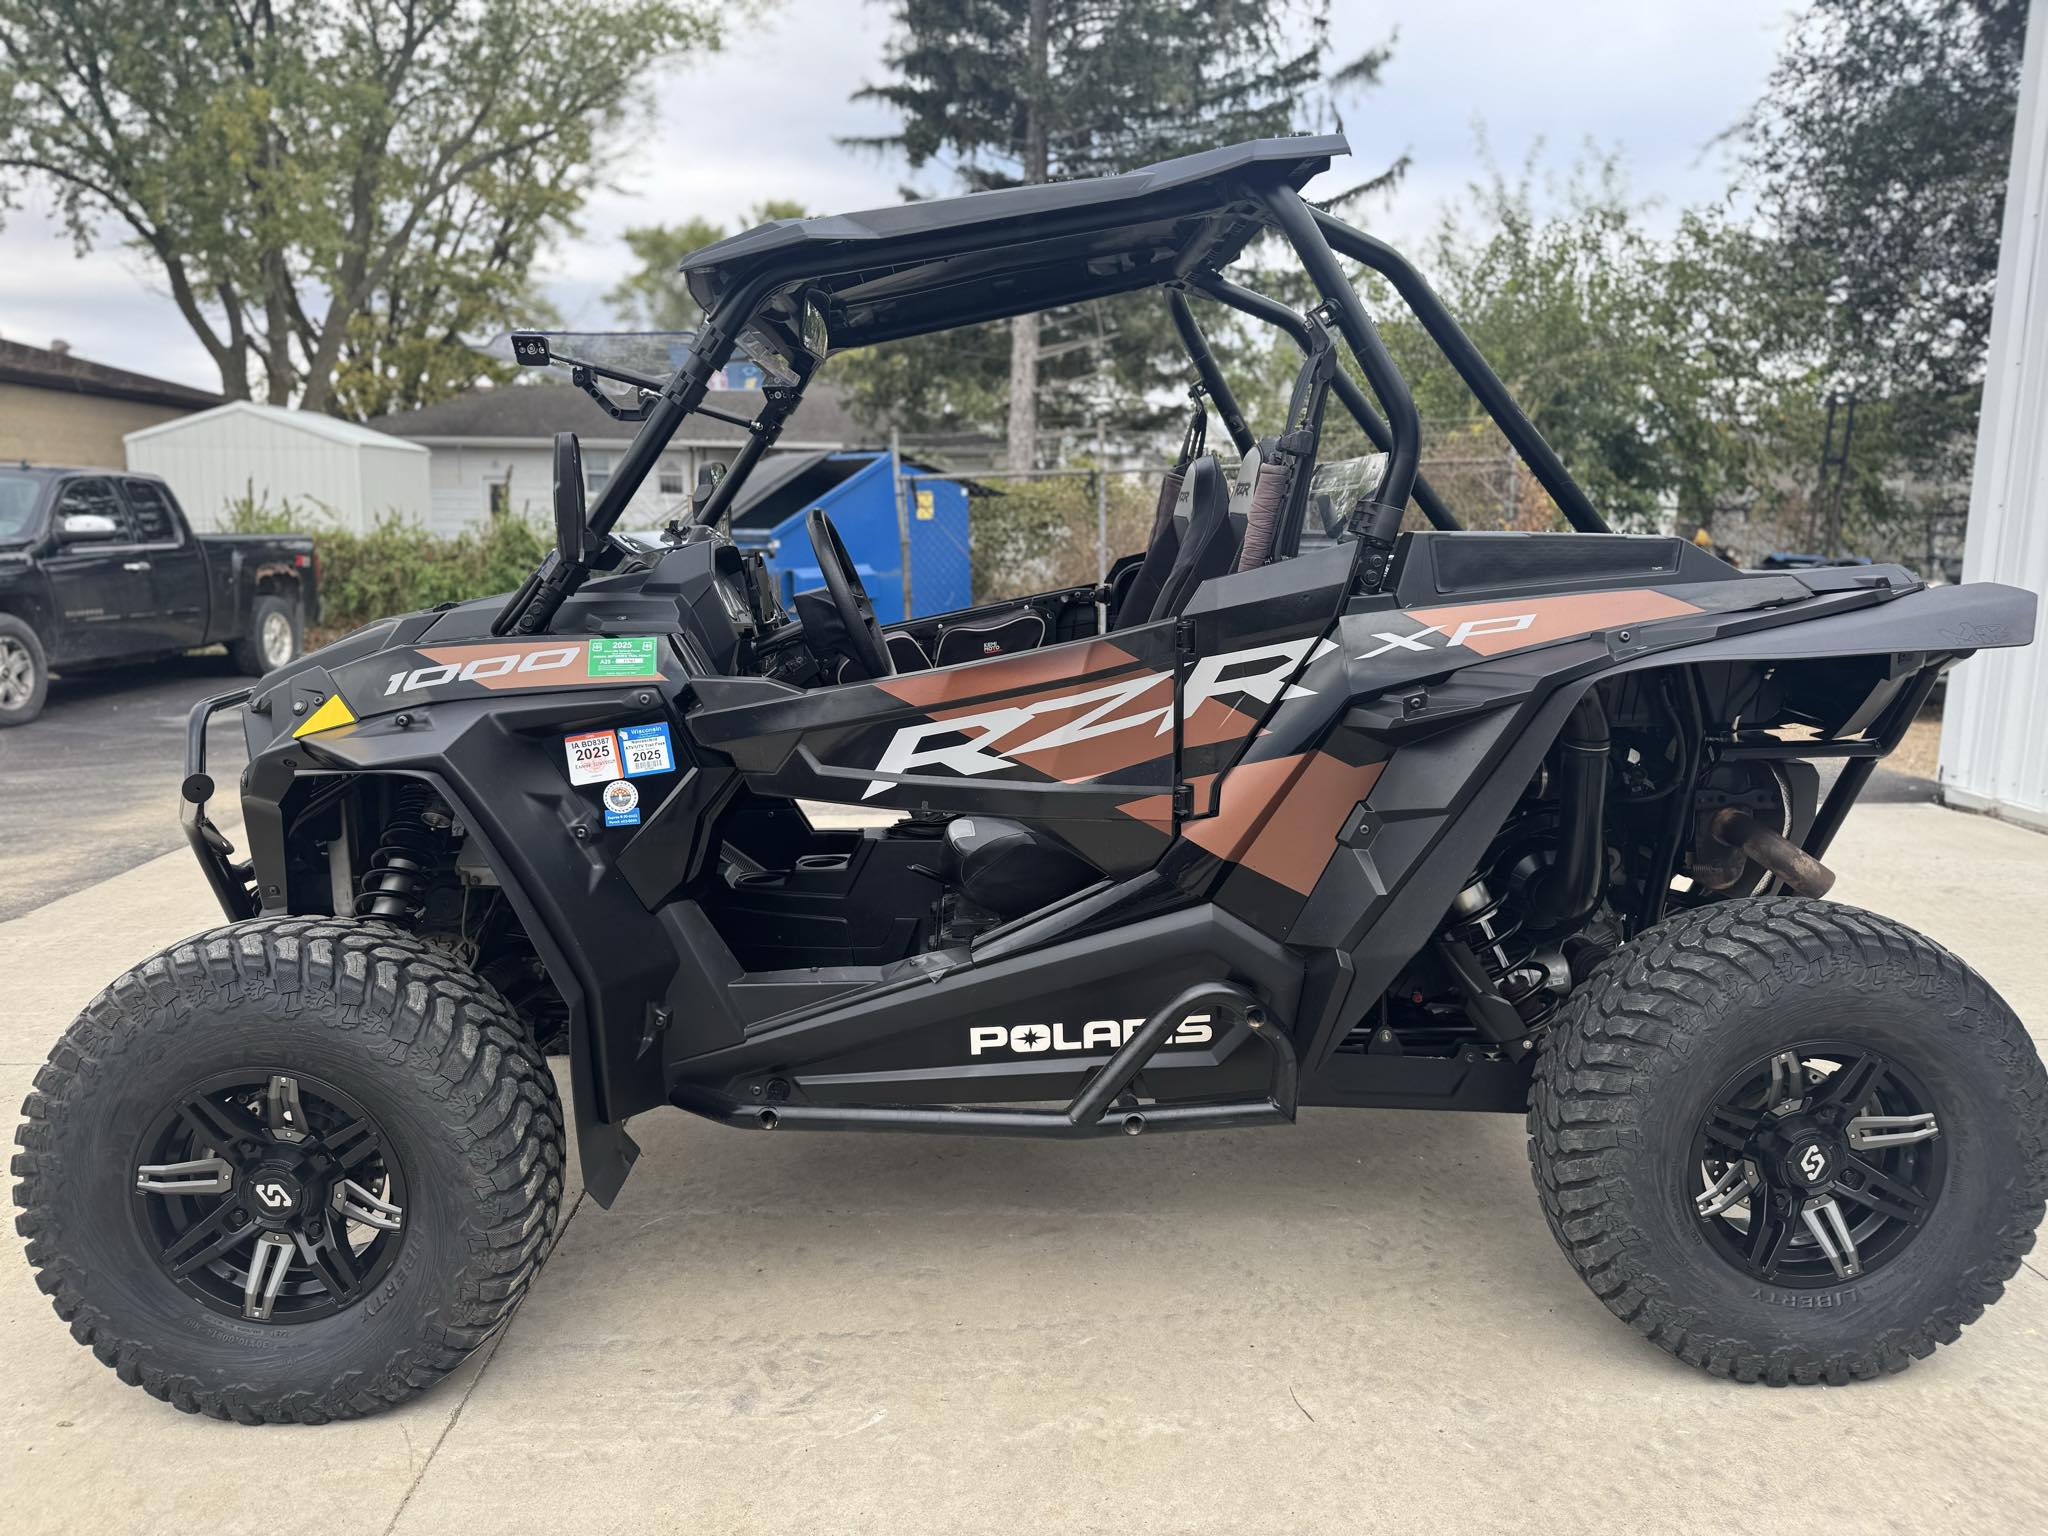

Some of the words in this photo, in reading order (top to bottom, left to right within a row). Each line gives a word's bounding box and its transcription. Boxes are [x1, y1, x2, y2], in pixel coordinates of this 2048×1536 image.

[612, 641, 633, 649] 2025
[1353, 613, 1537, 661] XP
[384, 646, 581, 697] 1000
[861, 636, 1340, 801] RZR
[630, 725, 662, 736] Wisconsin
[575, 745, 610, 761] 2025
[632, 749, 661, 762] 2025
[1751, 1287, 1858, 1308] LIBERTY
